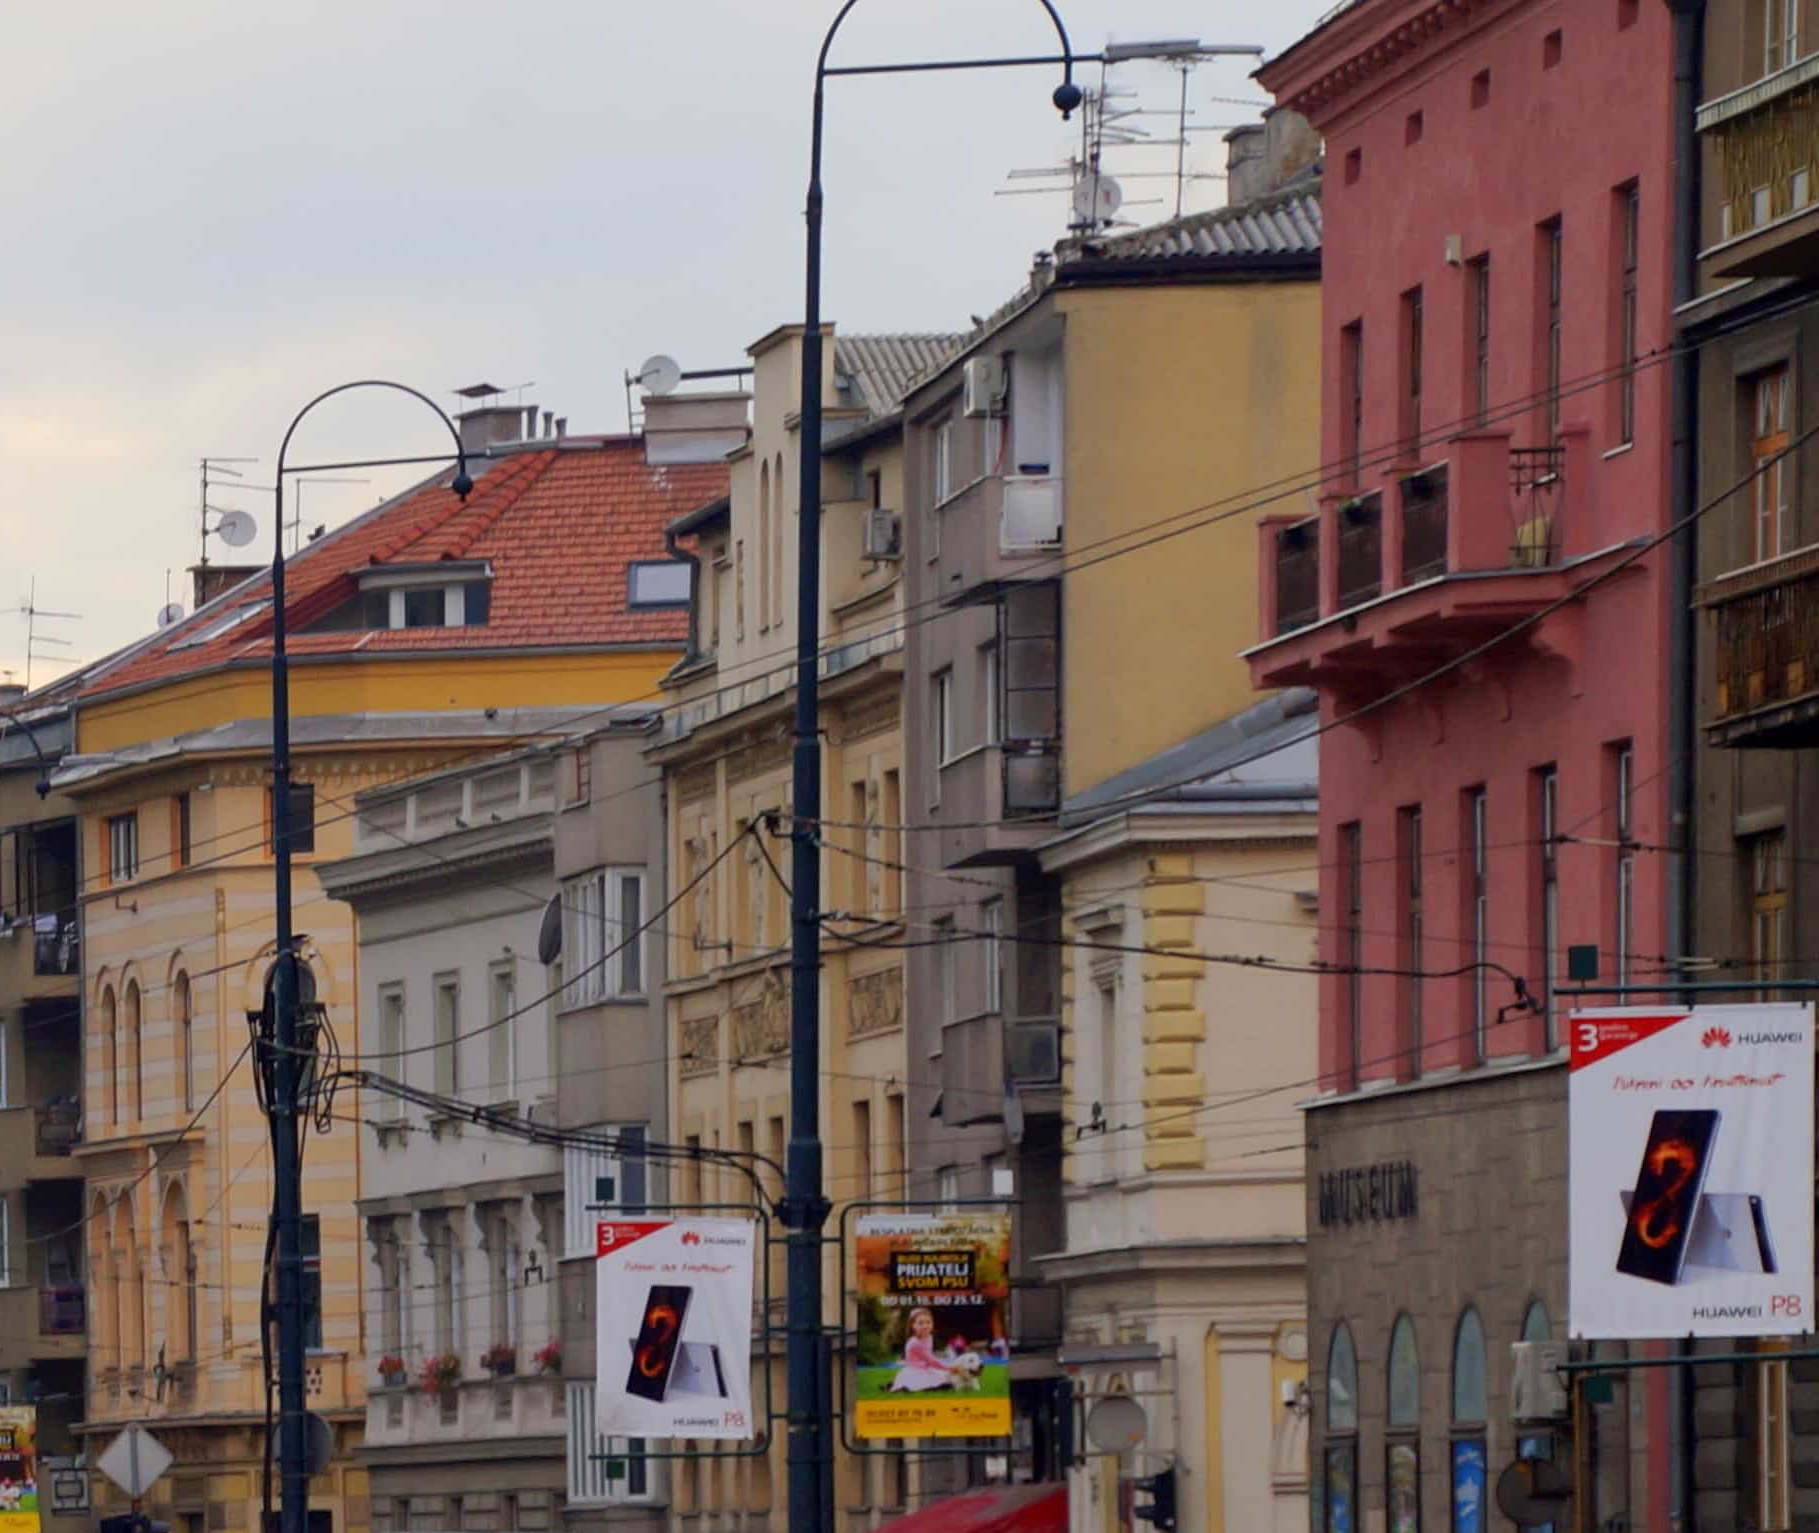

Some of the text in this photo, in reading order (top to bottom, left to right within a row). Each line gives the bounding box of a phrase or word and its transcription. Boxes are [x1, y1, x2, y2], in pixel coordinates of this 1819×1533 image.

[1578, 1024, 1598, 1052] 3
[1737, 1032, 1803, 1044] HUAWEI
[602, 1228, 615, 1246] 3
[896, 1263, 969, 1276] PRIJATELJ
[897, 1276, 969, 1289] SVOM PSU
[1692, 1306, 1762, 1319] HUAWEI
[1771, 1295, 1802, 1317] P8
[724, 1411, 745, 1427] P8
